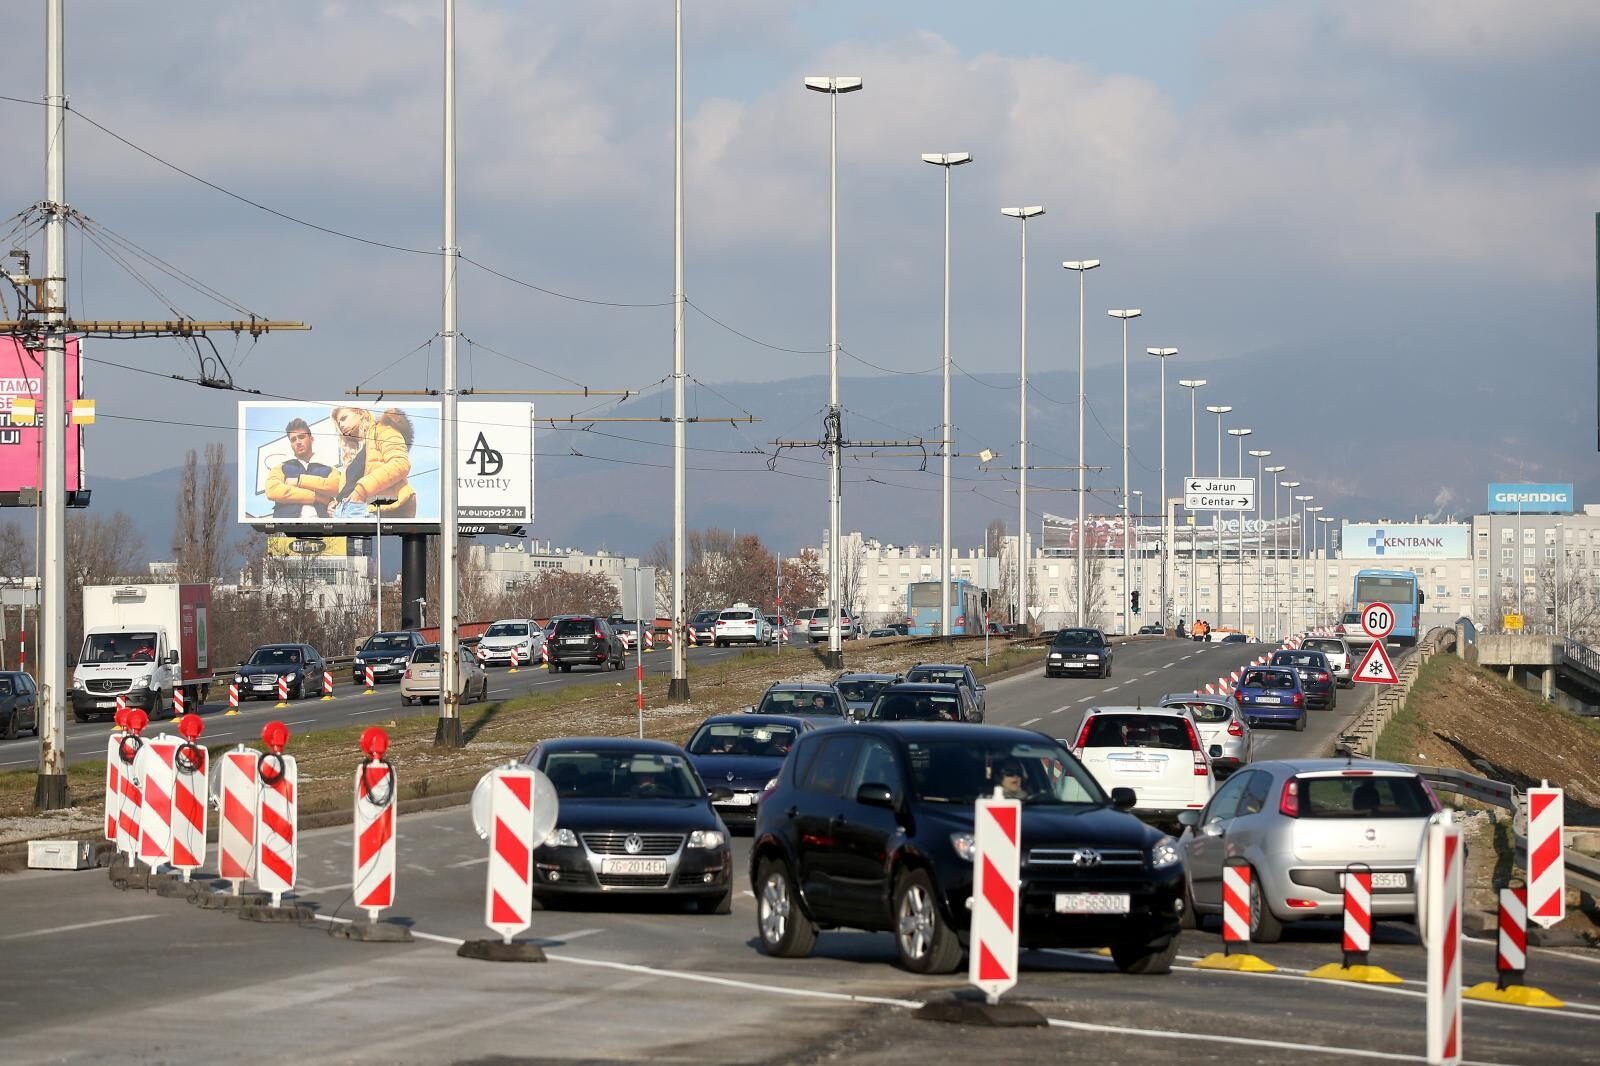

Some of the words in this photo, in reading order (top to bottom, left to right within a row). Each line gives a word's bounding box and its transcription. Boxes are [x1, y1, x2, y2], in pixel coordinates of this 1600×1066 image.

[457, 477, 511, 491] twenty
[1205, 482, 1236, 491] Jarun
[1201, 496, 1235, 506] Centar
[1383, 537, 1444, 548] KENTBANK
[1368, 611, 1388, 630] 60
